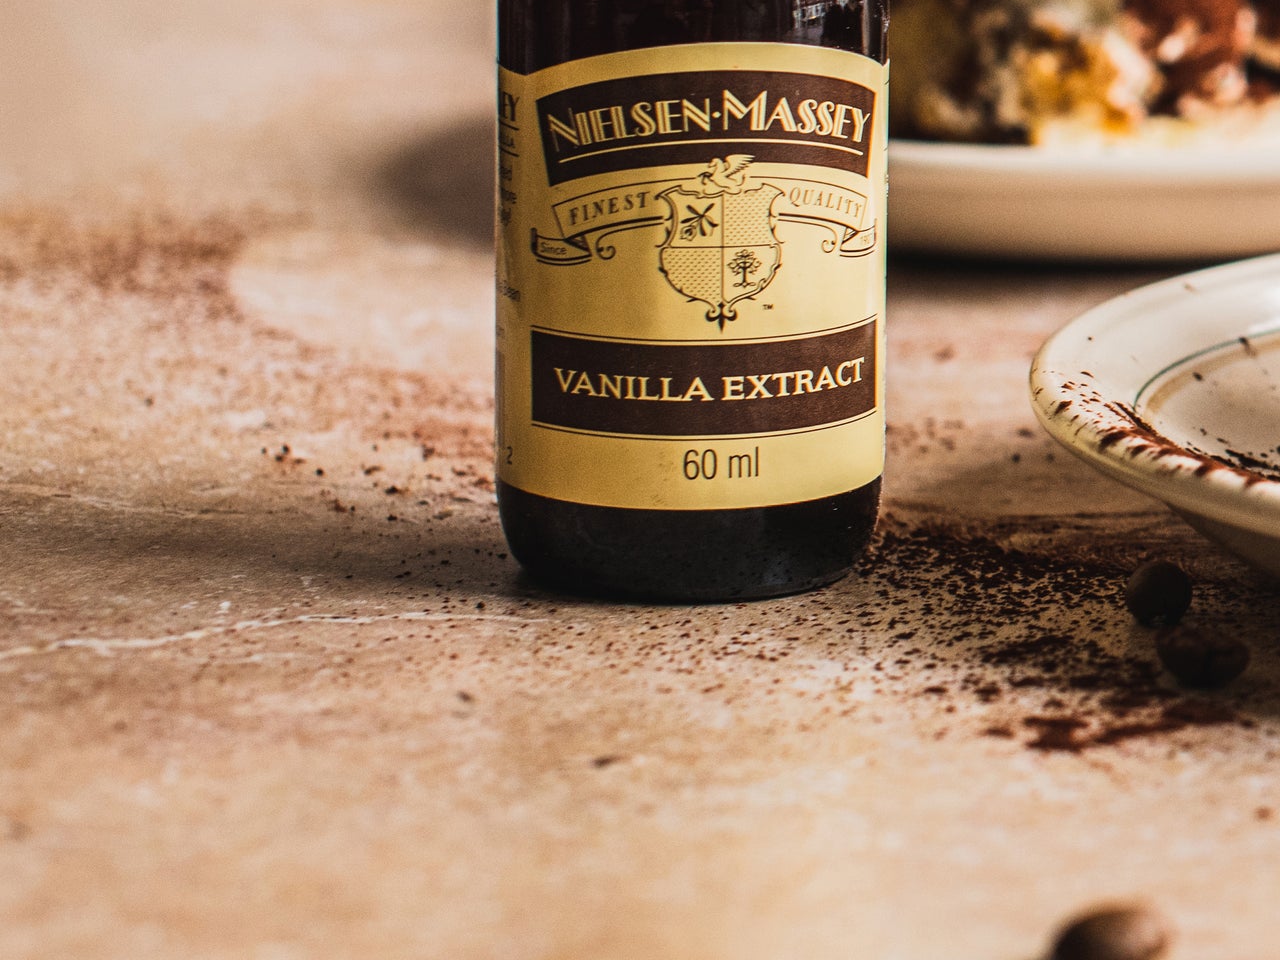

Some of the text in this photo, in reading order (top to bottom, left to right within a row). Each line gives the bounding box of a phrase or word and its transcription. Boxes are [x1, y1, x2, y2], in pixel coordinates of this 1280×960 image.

[568, 187, 862, 225] FINEST QUALITY
[541, 242, 567, 256] Since
[554, 356, 865, 402] VANILLA EXTRACT
[683, 446, 760, 481] 60 ml
